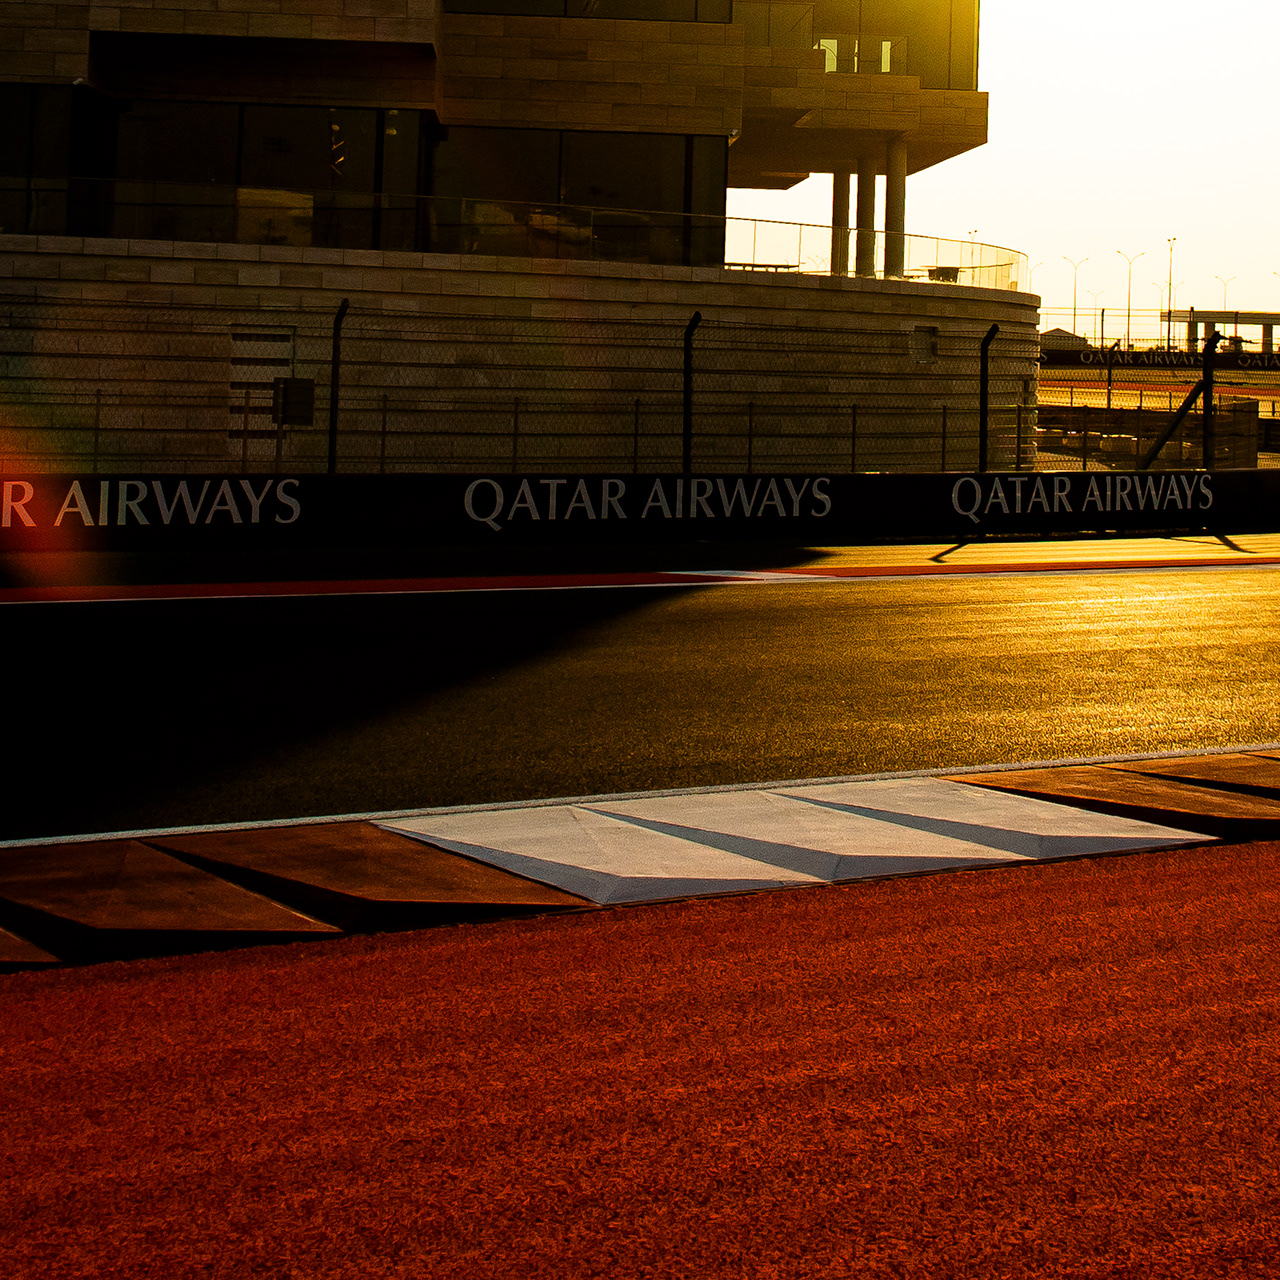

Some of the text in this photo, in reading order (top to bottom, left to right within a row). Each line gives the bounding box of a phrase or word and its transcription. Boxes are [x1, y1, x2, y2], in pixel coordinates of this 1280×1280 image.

[1138, 352, 1204, 366] AIRWAYS
[54, 478, 302, 527] AIRWAYS
[463, 477, 832, 532] QATAR AIRWAYS
[951, 474, 1214, 523] QATAR AIRWAYS
